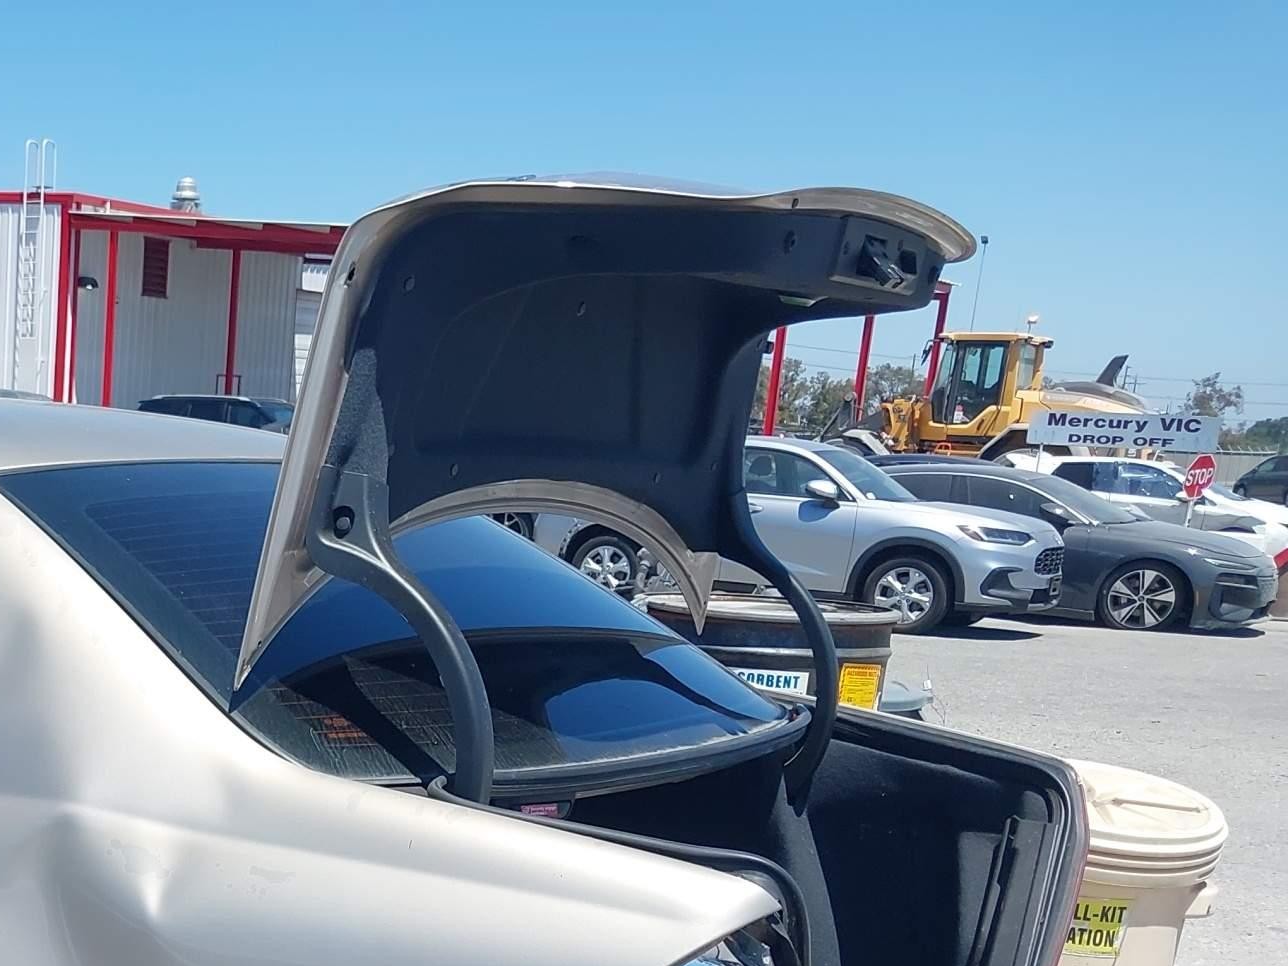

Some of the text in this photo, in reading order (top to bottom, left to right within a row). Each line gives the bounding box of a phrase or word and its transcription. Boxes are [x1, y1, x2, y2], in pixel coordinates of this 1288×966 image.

[1047, 412, 1202, 433] Mercury VIC
[1068, 433, 1176, 448] DROP OFF
[1185, 467, 1214, 487] STOP
[1073, 903, 1128, 924] LL-KIT
[1065, 926, 1116, 948] ATION
